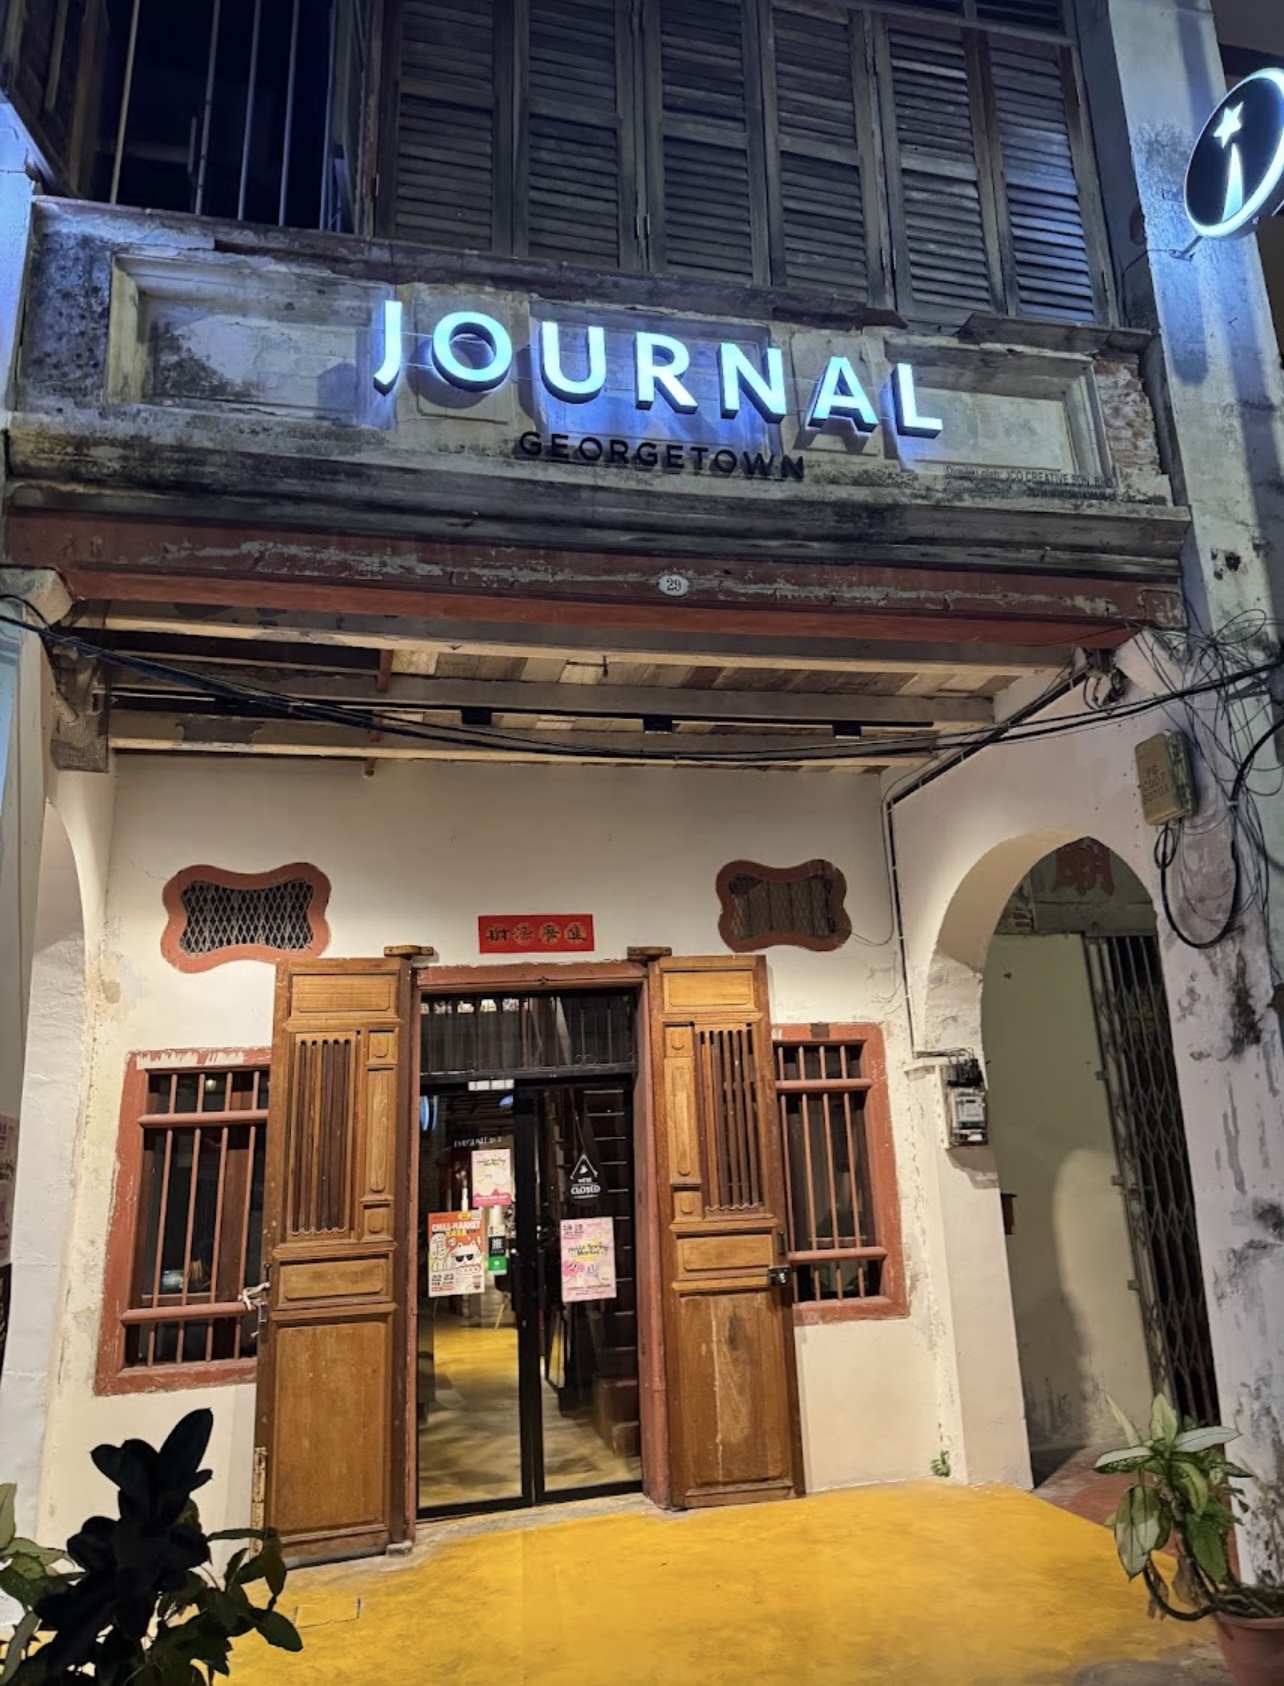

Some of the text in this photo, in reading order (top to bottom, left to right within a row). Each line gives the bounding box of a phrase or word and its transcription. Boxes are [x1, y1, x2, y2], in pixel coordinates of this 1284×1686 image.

[373, 300, 943, 438] JOURNAL
[519, 430, 805, 481] GEORGETOWN
[1025, 470, 1069, 485] CREATIVE
[667, 578, 682, 591] 29
[571, 1184, 601, 1195] CLOSED
